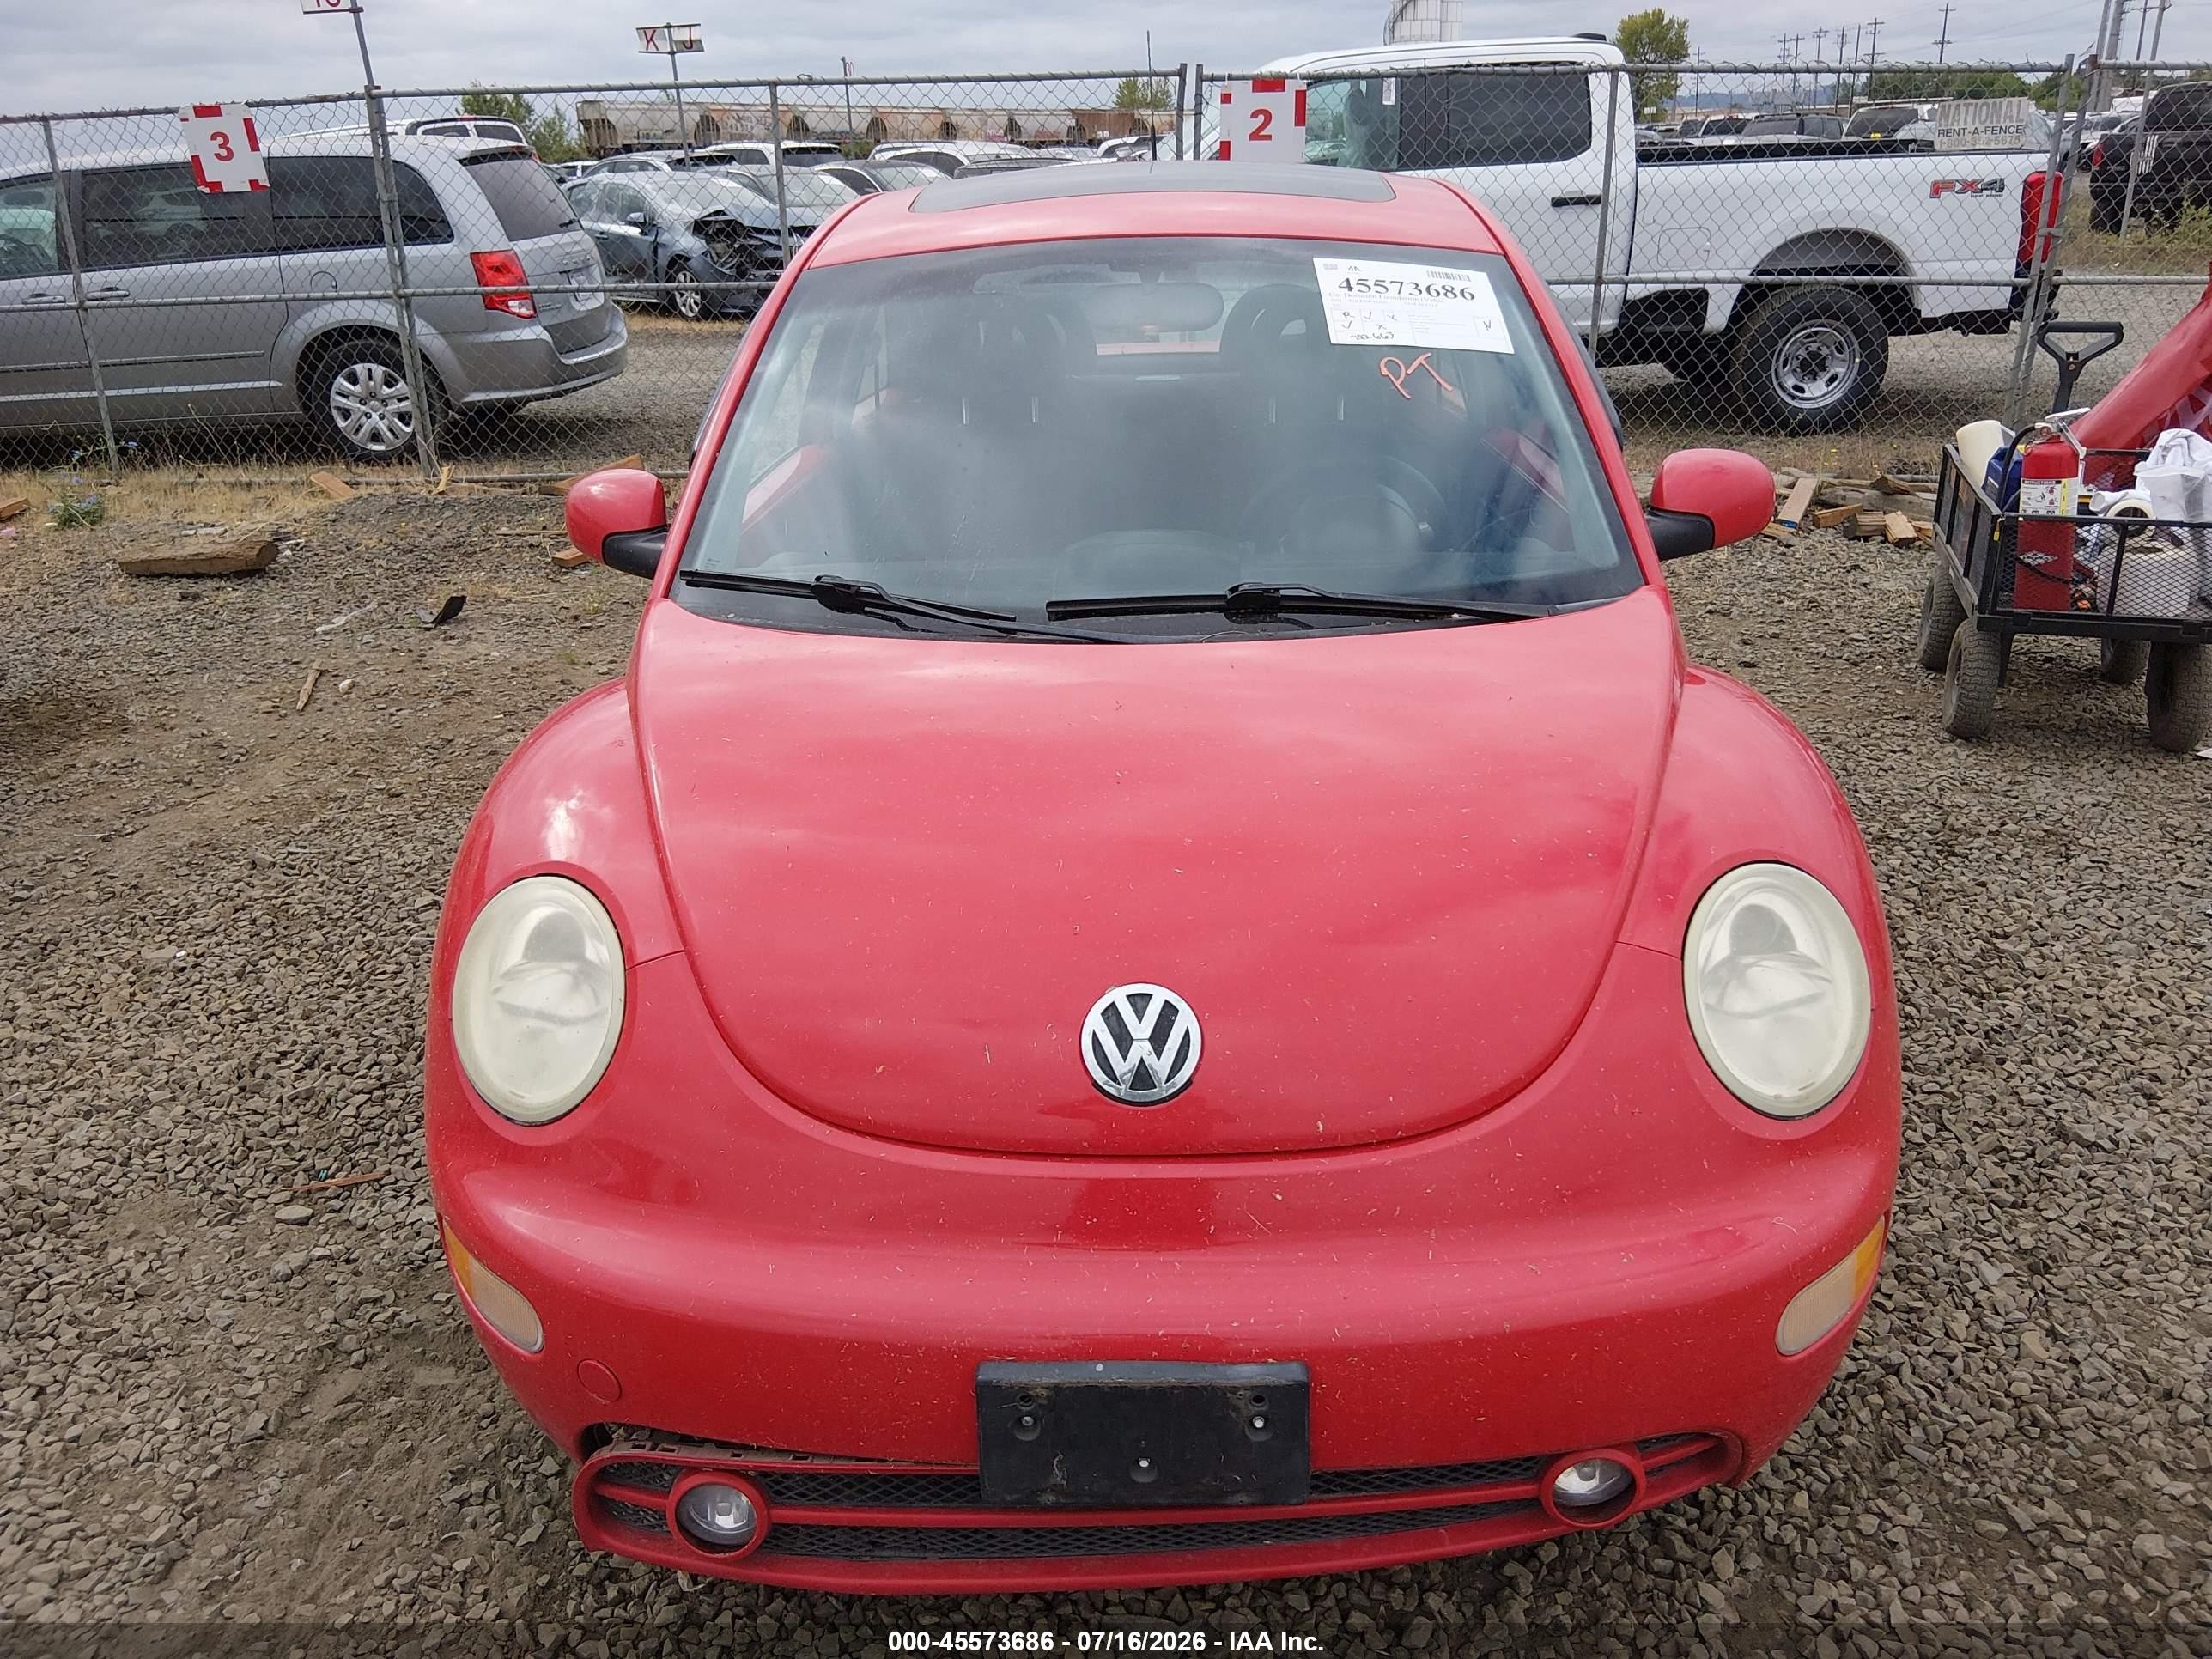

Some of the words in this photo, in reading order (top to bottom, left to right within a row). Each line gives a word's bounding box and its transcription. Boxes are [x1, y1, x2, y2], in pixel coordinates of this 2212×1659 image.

[643, 29, 659, 52] K
[682, 27, 694, 50] J
[1249, 108, 1273, 142] 2
[1937, 100, 2024, 127] NATIONAL
[1937, 125, 2025, 138] RENT-A-FENCE
[210, 131, 234, 162] 3
[1929, 177, 2005, 198] FX4
[1338, 277, 1475, 301] 45573686
